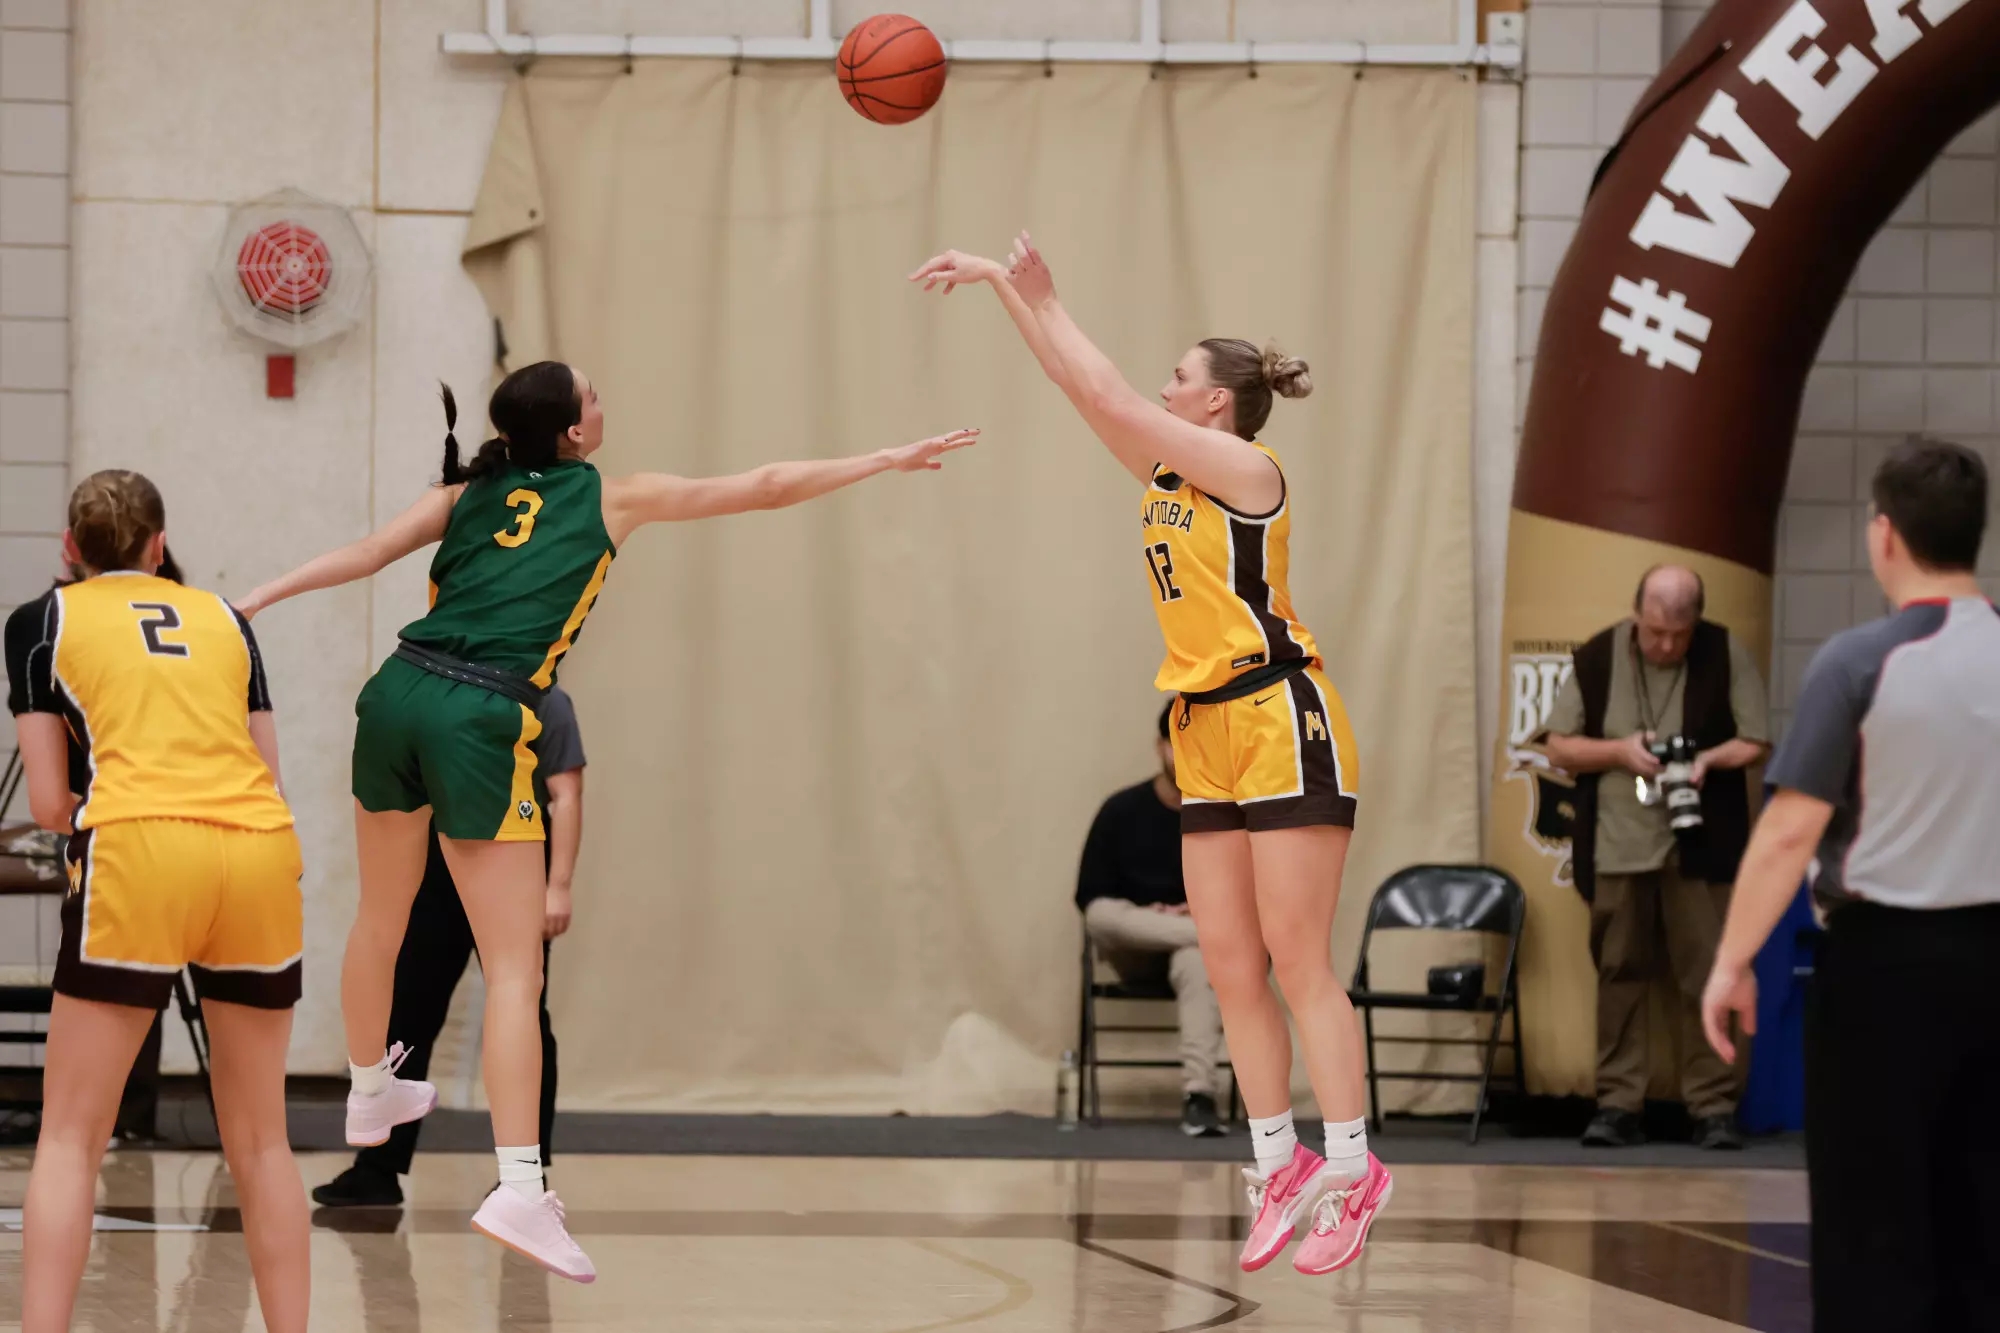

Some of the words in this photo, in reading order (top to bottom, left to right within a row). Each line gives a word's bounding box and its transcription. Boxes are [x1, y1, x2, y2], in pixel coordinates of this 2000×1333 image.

[493, 487, 544, 548] 3
[1145, 541, 1184, 603] 12
[129, 601, 190, 658] 2
[1304, 710, 1327, 741] M
